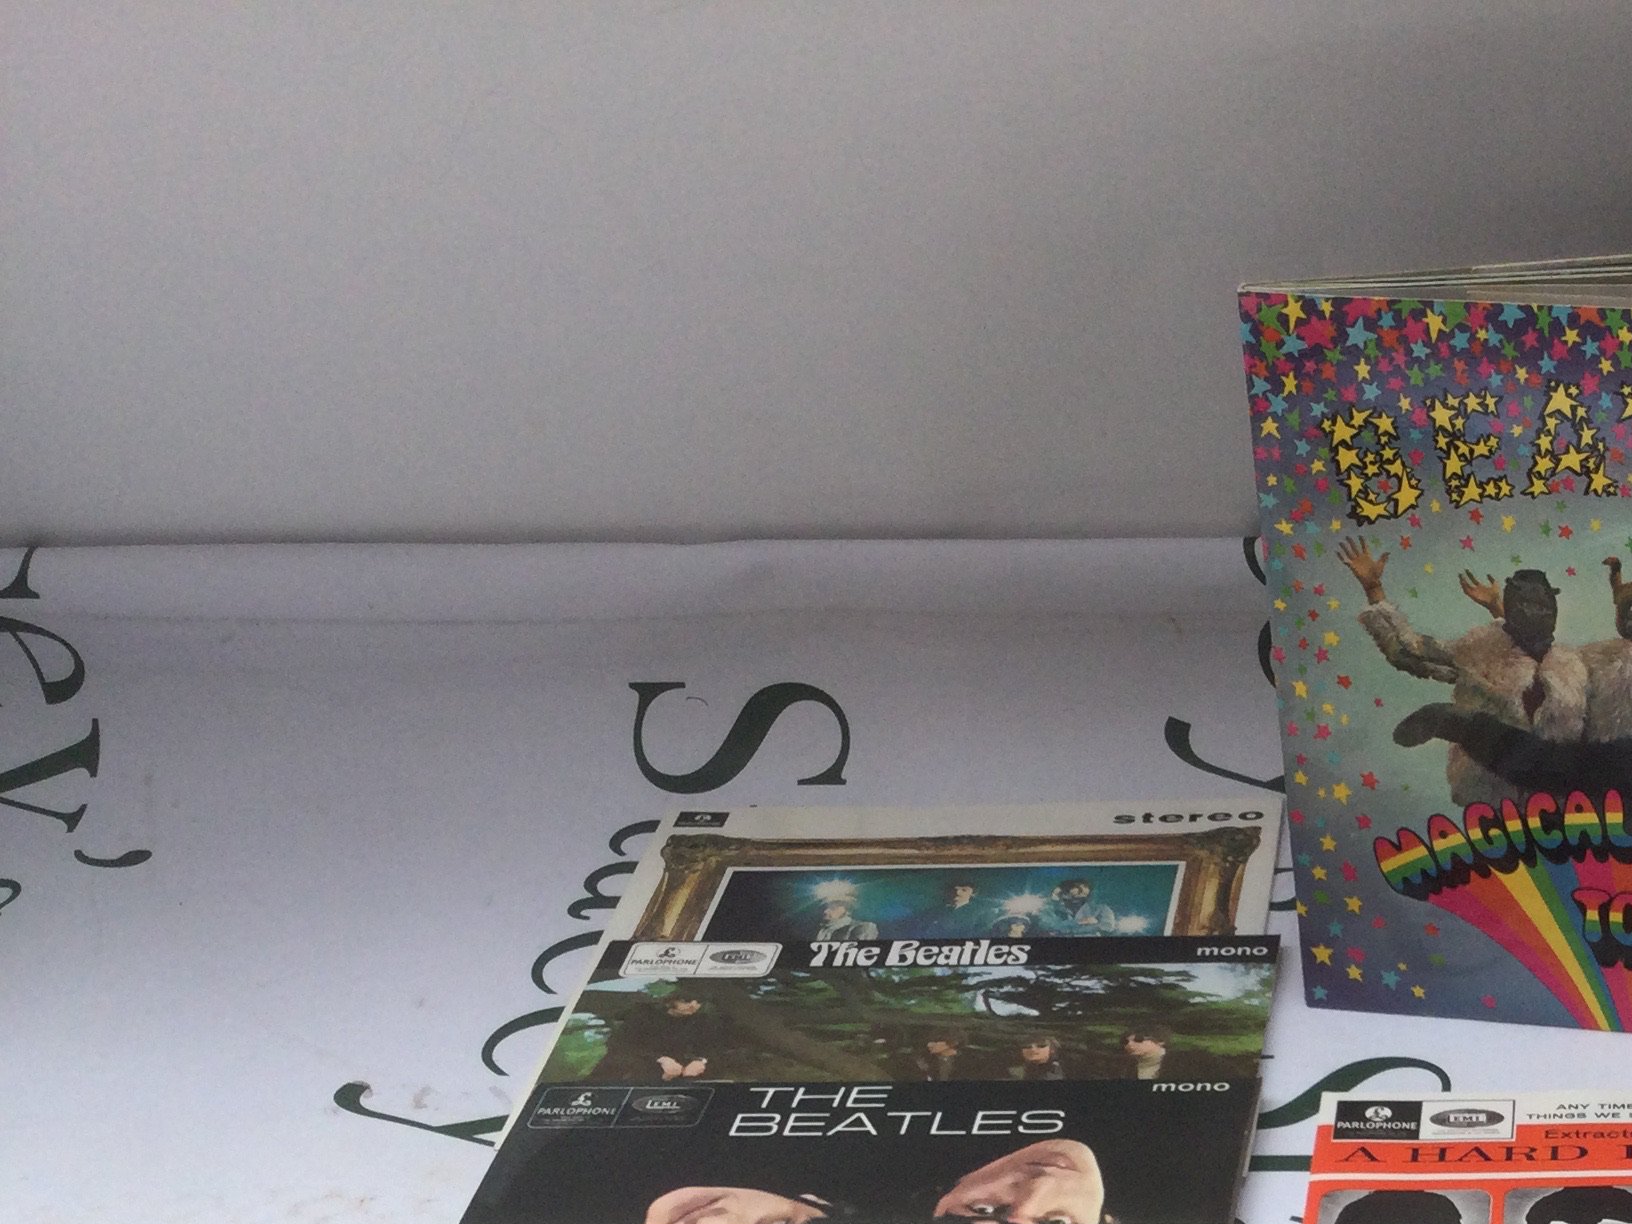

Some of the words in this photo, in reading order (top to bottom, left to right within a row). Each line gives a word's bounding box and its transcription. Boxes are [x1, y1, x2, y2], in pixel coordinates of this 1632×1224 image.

[1112, 807, 1265, 827] stereo
[809, 940, 880, 967] The
[884, 939, 1031, 966] Beatles
[1196, 945, 1269, 957] mono
[631, 958, 698, 966] PARLOPHONE
[1152, 1081, 1231, 1093] mono
[750, 1085, 893, 1108] THE
[728, 1109, 1066, 1136] BEATLES
[1527, 1112, 1587, 1120] THINGS
[1336, 1120, 1418, 1131] PARLOPHONE
[1335, 1145, 1387, 1164] A
[1401, 1143, 1589, 1164] HARD
